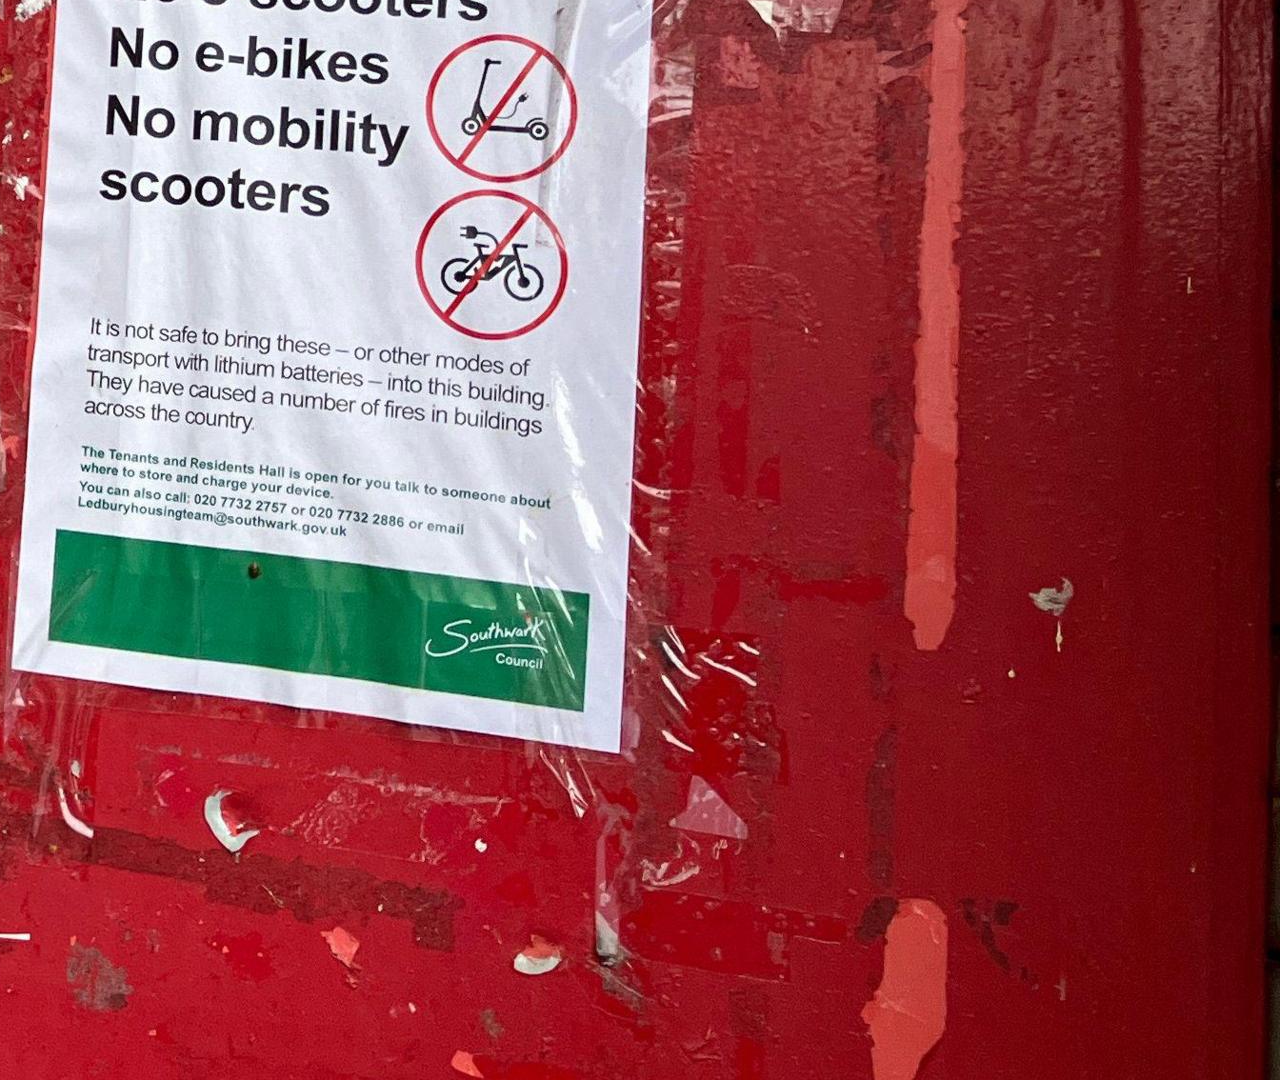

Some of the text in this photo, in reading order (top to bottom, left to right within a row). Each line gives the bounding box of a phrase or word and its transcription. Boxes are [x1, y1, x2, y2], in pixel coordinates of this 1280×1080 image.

[110, 27, 389, 84] No e-bikes
[106, 94, 410, 167] No mobility
[99, 168, 330, 217] scooters
[91, 317, 531, 376] It is not safe to bring these or other modes of
[86, 369, 542, 437] They have caused a number of fires in buildings
[88, 344, 549, 411] transport with lithium batteries into this building.
[84, 400, 253, 434] across the country.
[80, 462, 333, 499] where to store and charge your device.
[82, 445, 551, 509] The Tenants and Residents Hall is open for you talk to someone about
[78, 496, 346, 536] Ledburyhousingteam@southwark.gov.uk
[79, 481, 464, 535] You can also call: 020 7732 2757 or 020 7732 2886 or email
[425, 617, 545, 657] Southwark
[495, 652, 543, 669] Council
